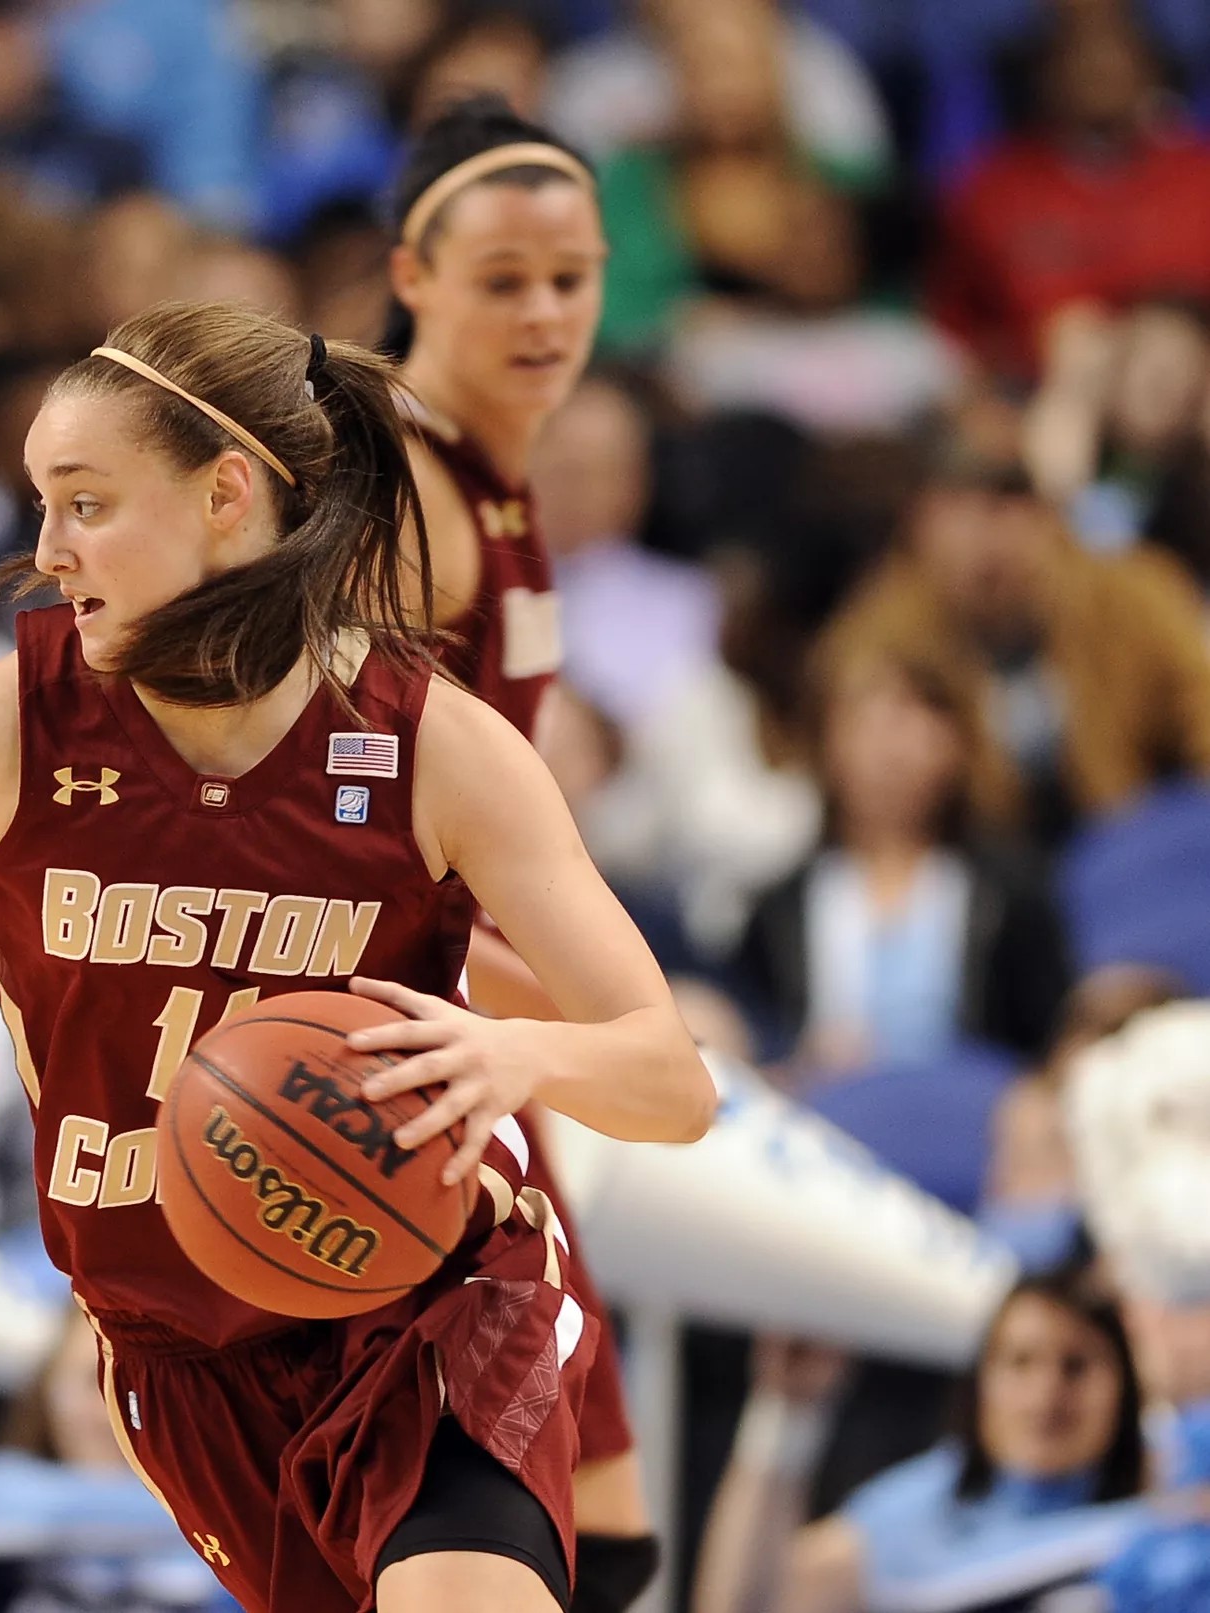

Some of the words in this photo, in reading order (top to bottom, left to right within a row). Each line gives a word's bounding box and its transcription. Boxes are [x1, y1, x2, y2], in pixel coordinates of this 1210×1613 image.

[42, 868, 382, 977] BOSTON
[147, 986, 261, 1103] 1
[48, 1114, 164, 1209] CO
[203, 1104, 382, 1278] Wilson
